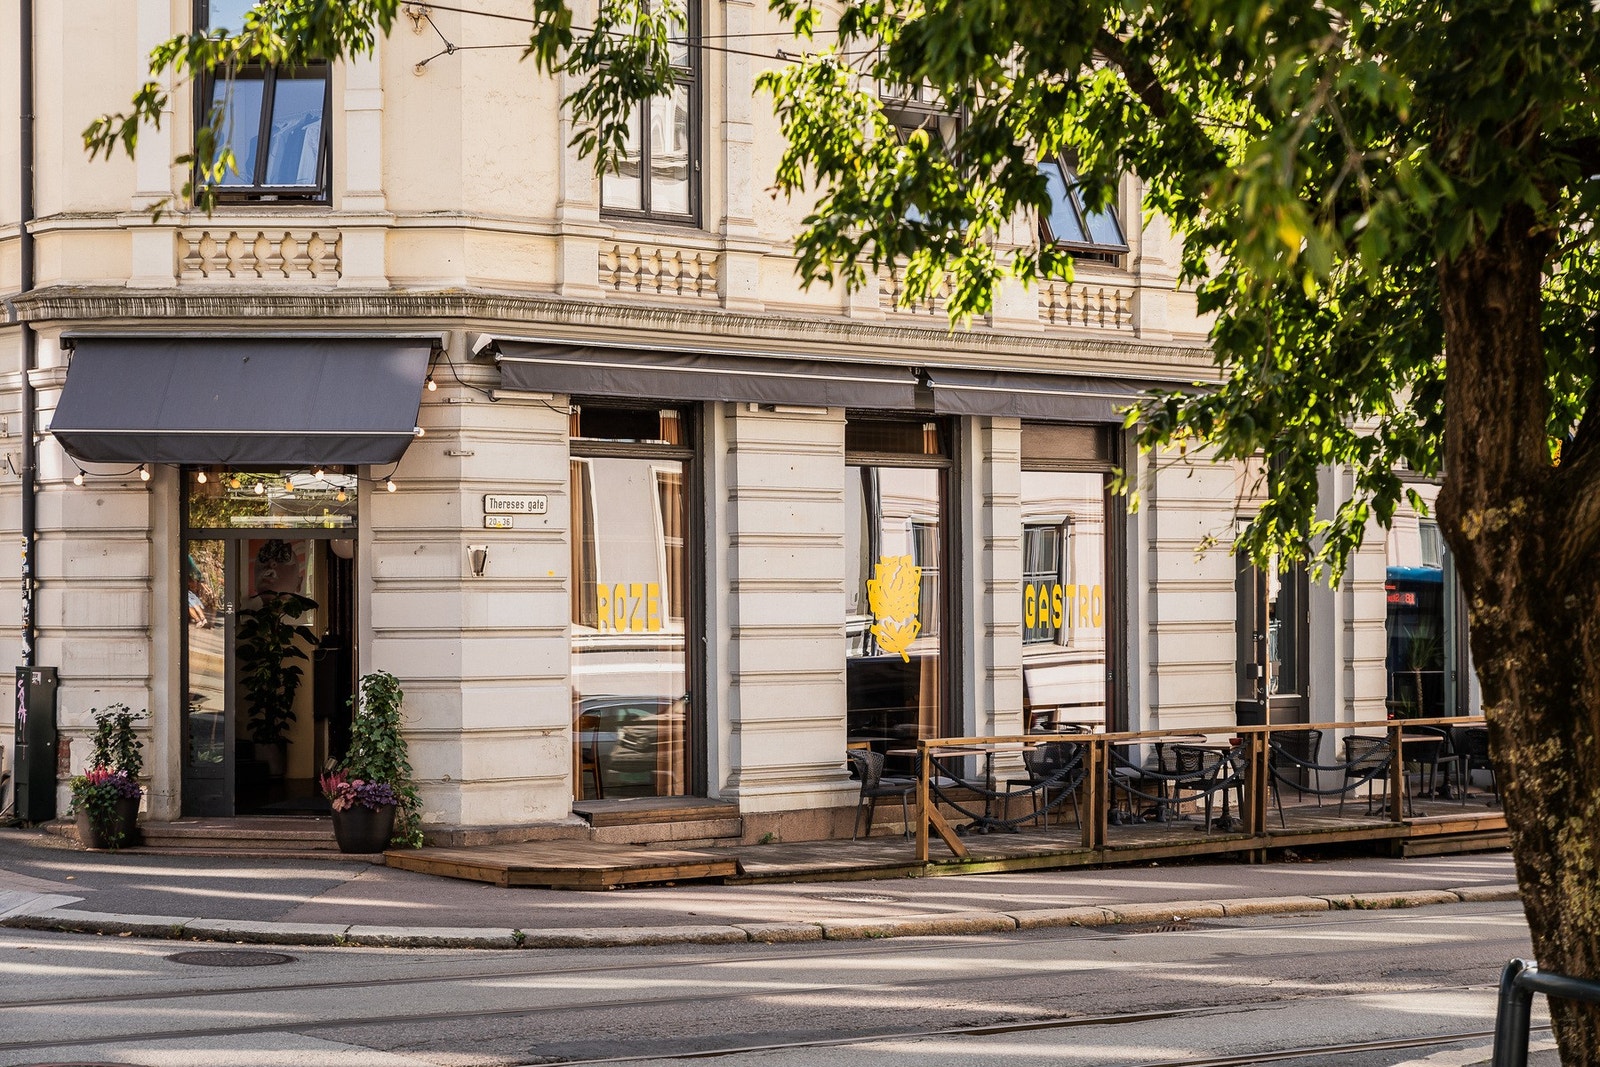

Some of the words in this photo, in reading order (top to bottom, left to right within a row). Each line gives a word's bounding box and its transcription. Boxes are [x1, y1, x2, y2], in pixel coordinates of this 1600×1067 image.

[489, 497, 525, 510] Thereses
[527, 499, 544, 512] gate
[597, 583, 660, 633] ROZE
[1025, 583, 1103, 629] GASTRO
